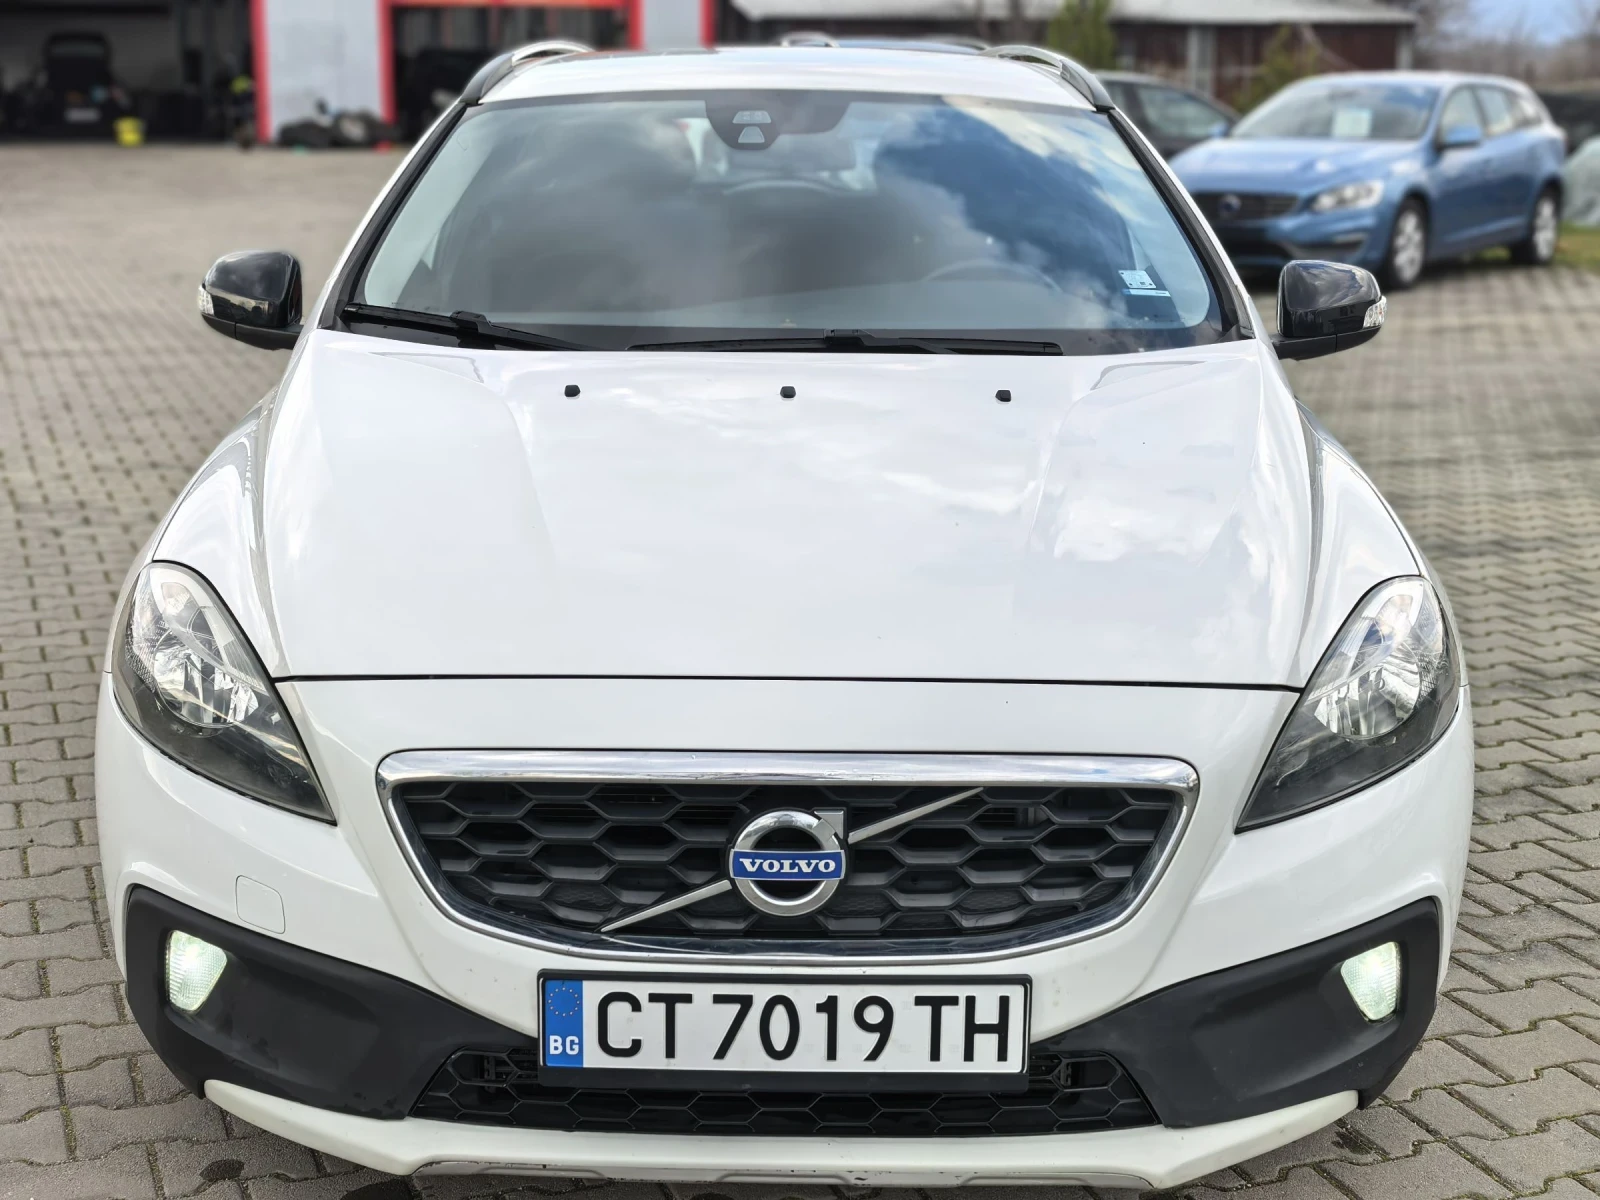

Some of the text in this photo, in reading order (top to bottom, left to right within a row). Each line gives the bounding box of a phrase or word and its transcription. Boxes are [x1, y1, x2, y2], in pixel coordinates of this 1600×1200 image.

[739, 858, 836, 873] VOLVO
[597, 991, 1010, 1063] CT 7019 TH
[549, 1034, 580, 1056] BG
